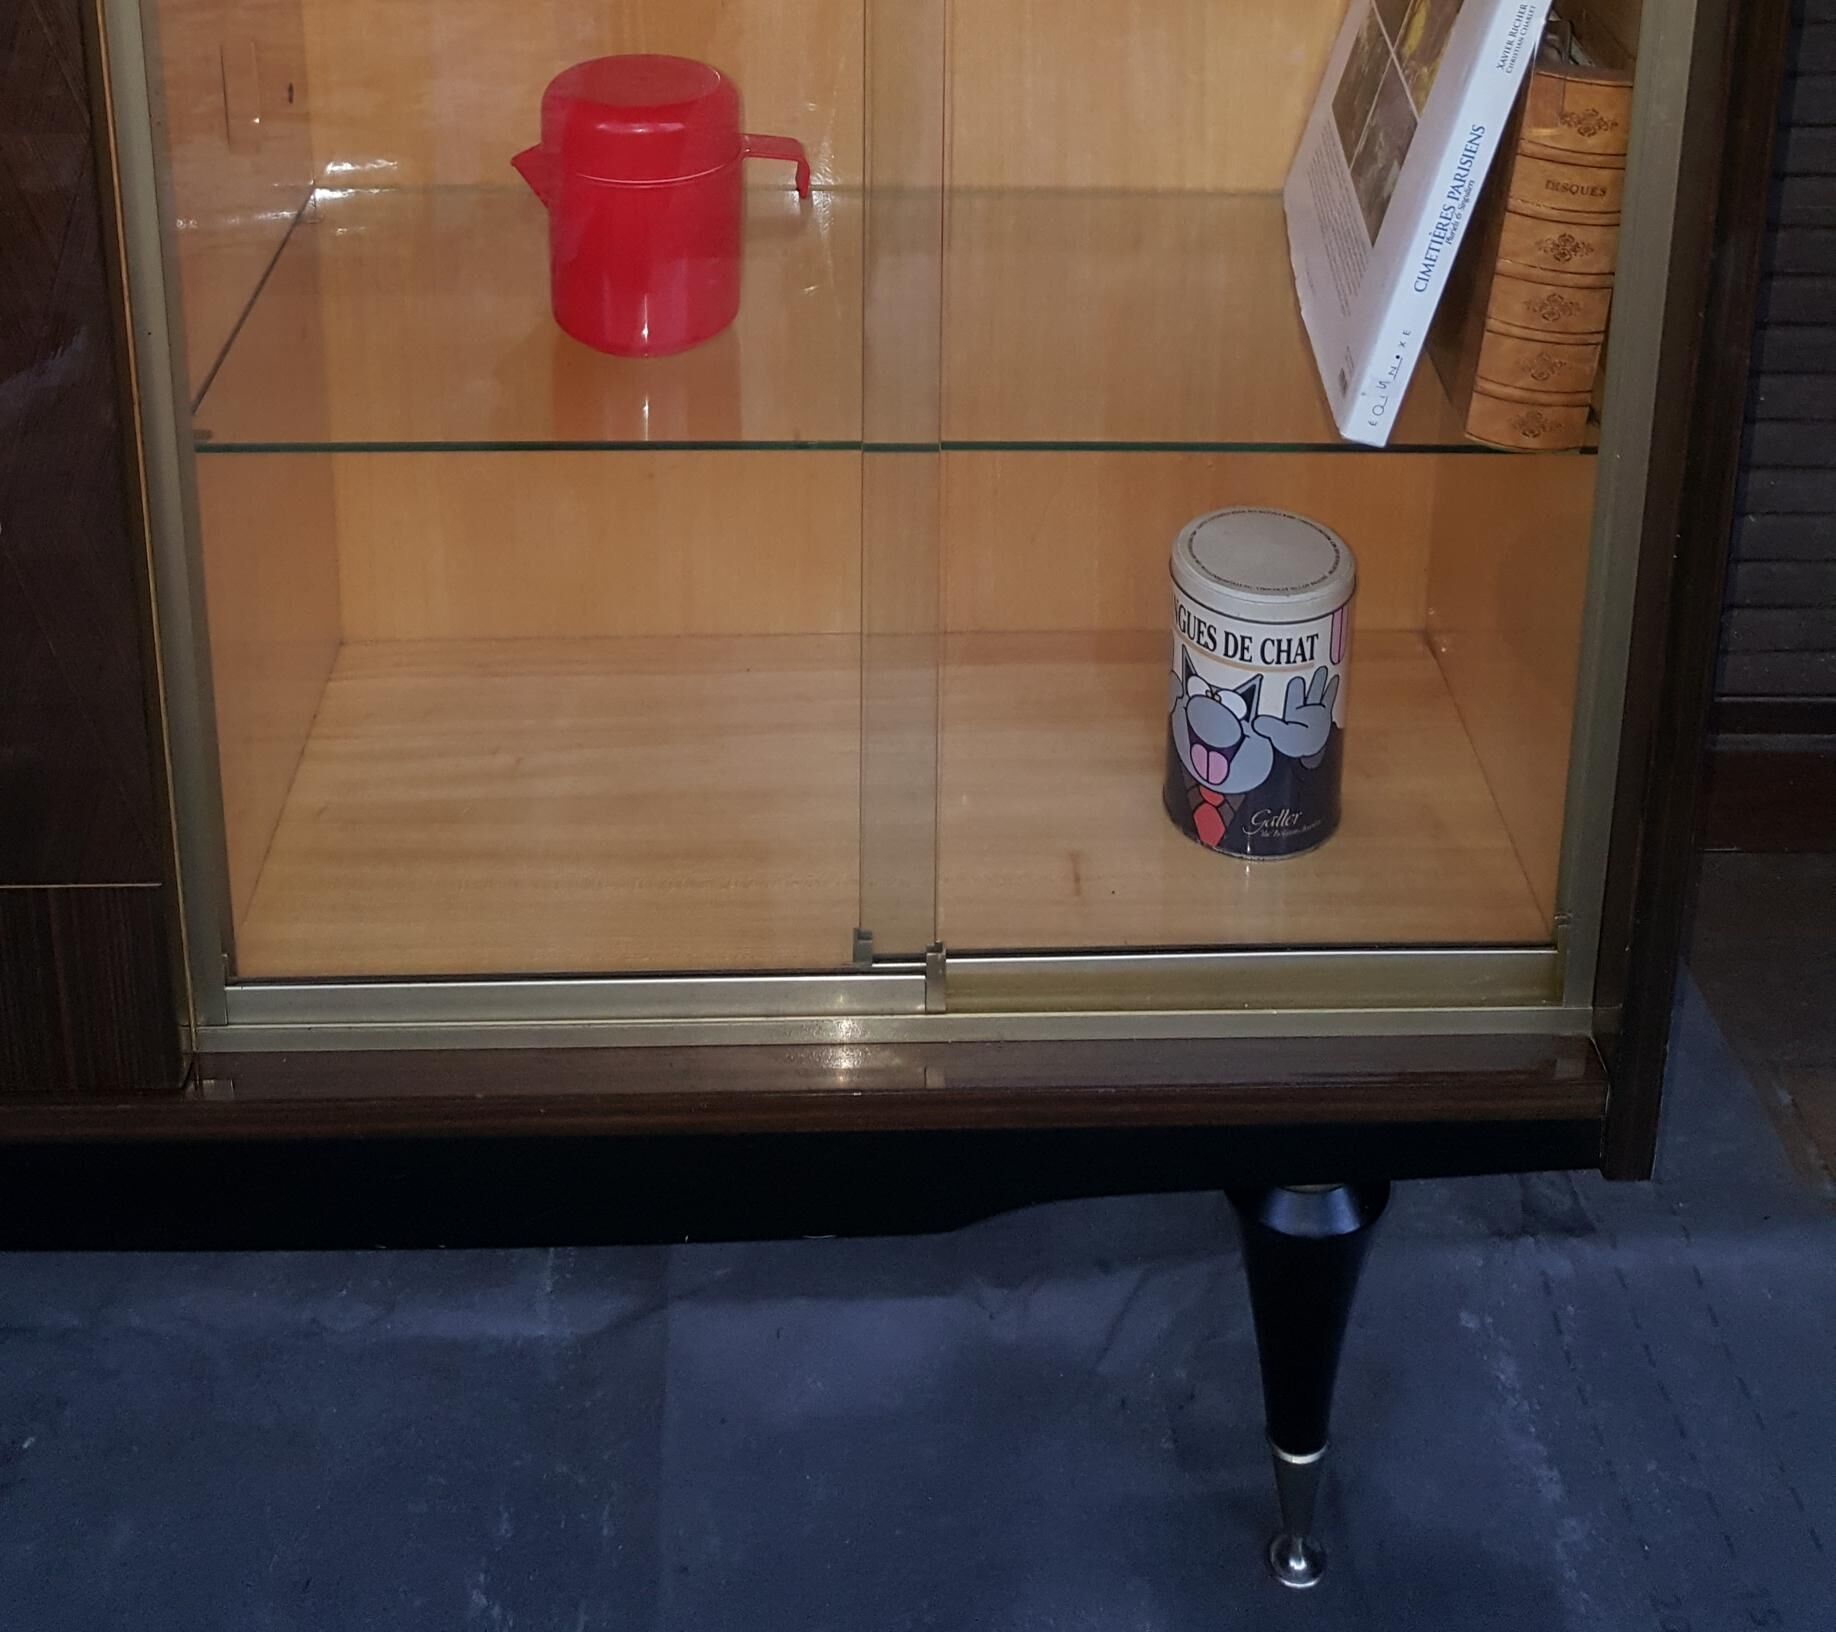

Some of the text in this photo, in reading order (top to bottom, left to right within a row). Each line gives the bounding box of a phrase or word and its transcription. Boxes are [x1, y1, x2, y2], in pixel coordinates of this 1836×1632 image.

[1496, 4, 1528, 71] XAVIER RICHER
[1413, 124, 1486, 293] CIMETIÈRES PARISIENS
[1545, 180, 1608, 197] DISQUES
[1223, 630, 1253, 663] DE
[1260, 632, 1319, 665] CHAT
